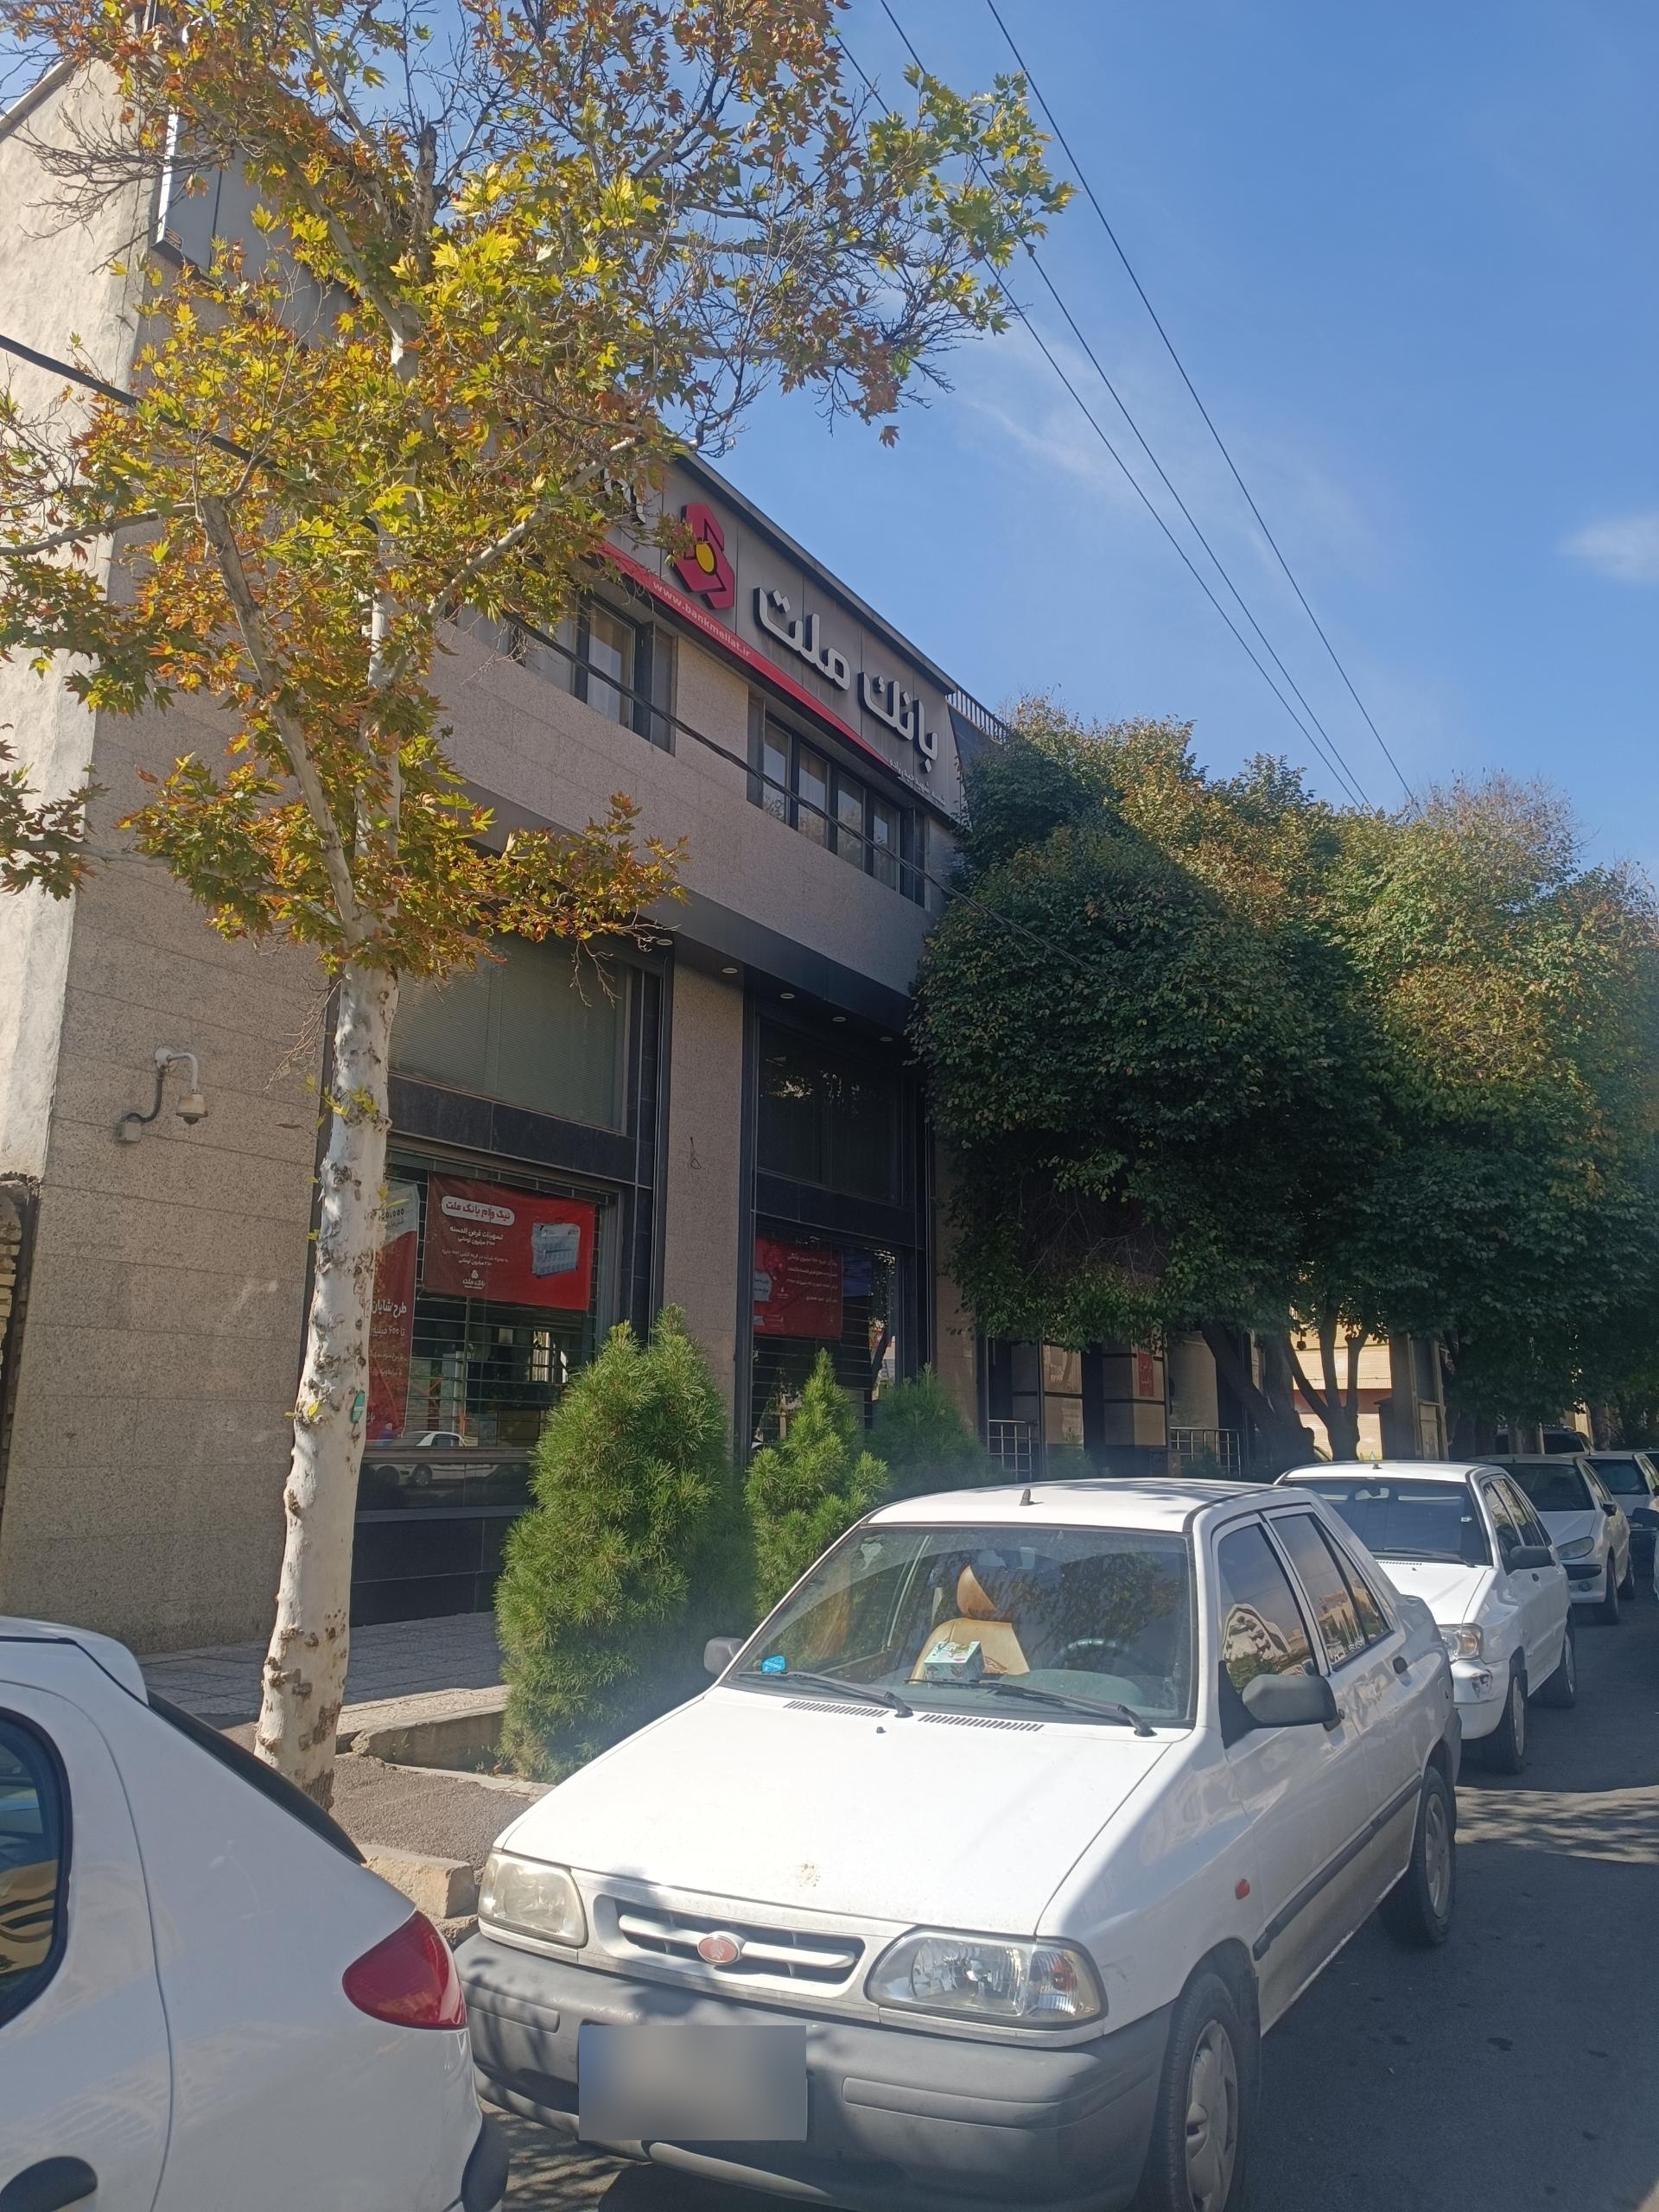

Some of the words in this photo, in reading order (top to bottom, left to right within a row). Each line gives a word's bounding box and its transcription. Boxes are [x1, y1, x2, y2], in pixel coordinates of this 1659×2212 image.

[652, 579, 752, 658] www.bankmellat.ir
[753, 586, 852, 692] ملت
[445, 1201, 461, 1211] ملت
[462, 1204, 480, 1217] بانک
[496, 1211, 511, 1221] نیک
[468, 1228, 481, 1238] قرض
[482, 1230, 504, 1241] تسهیلات
[393, 1301, 407, 1319] طرح
[400, 1326, 406, 1337] تا
